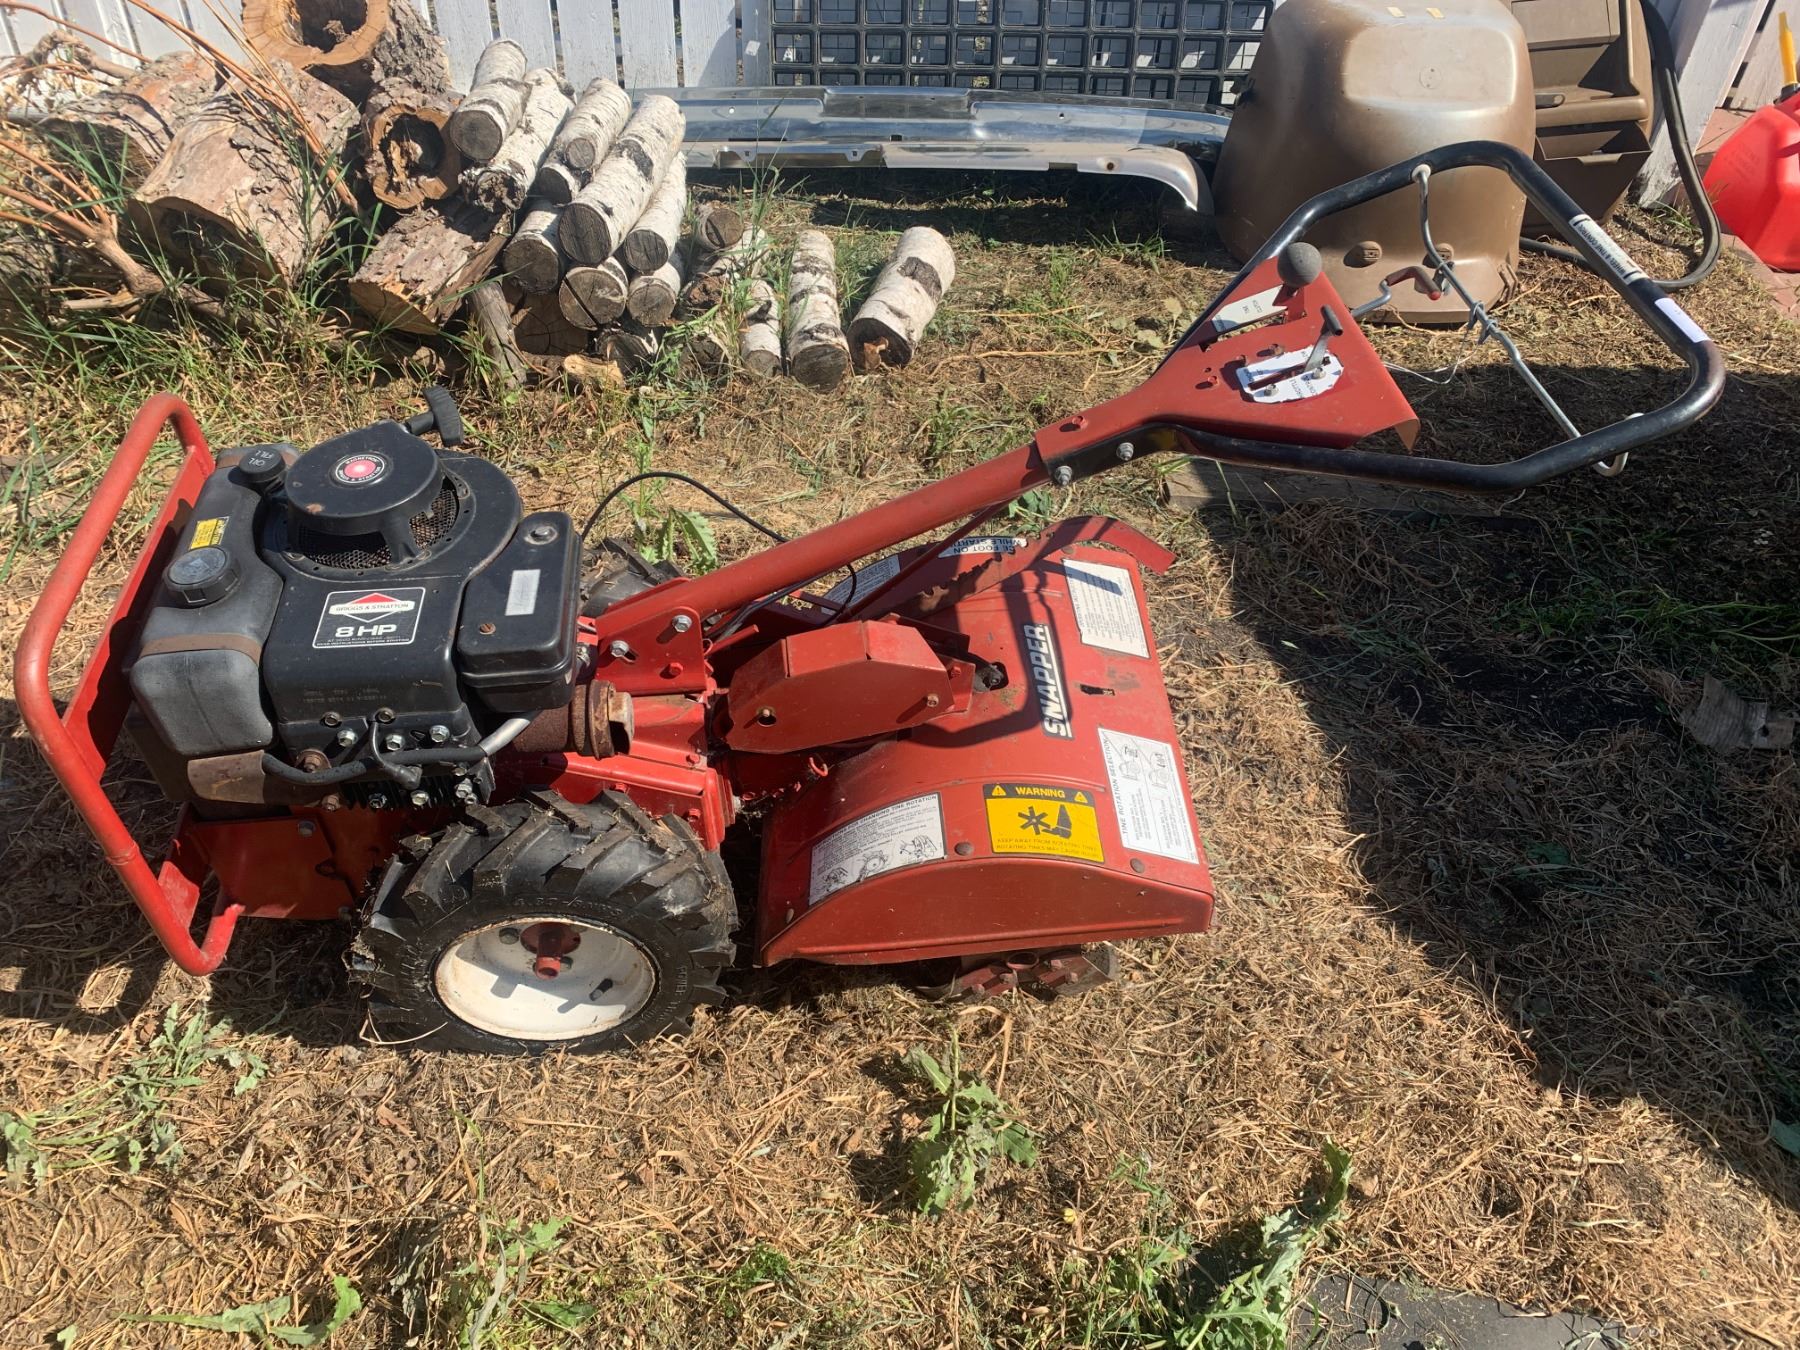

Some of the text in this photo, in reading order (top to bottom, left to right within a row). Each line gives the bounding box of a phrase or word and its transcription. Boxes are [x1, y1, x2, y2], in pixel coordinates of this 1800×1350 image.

[256, 450, 275, 459] FILL
[248, 457, 266, 467] OIL
[953, 545, 969, 554] ON
[335, 624, 397, 638] 8 HP
[1023, 624, 1068, 737] SNAPPER
[1015, 786, 1066, 799] WARNING
[1103, 739, 1128, 835] TINE ROTATION SELECTION
[905, 795, 937, 807] ROTATION
